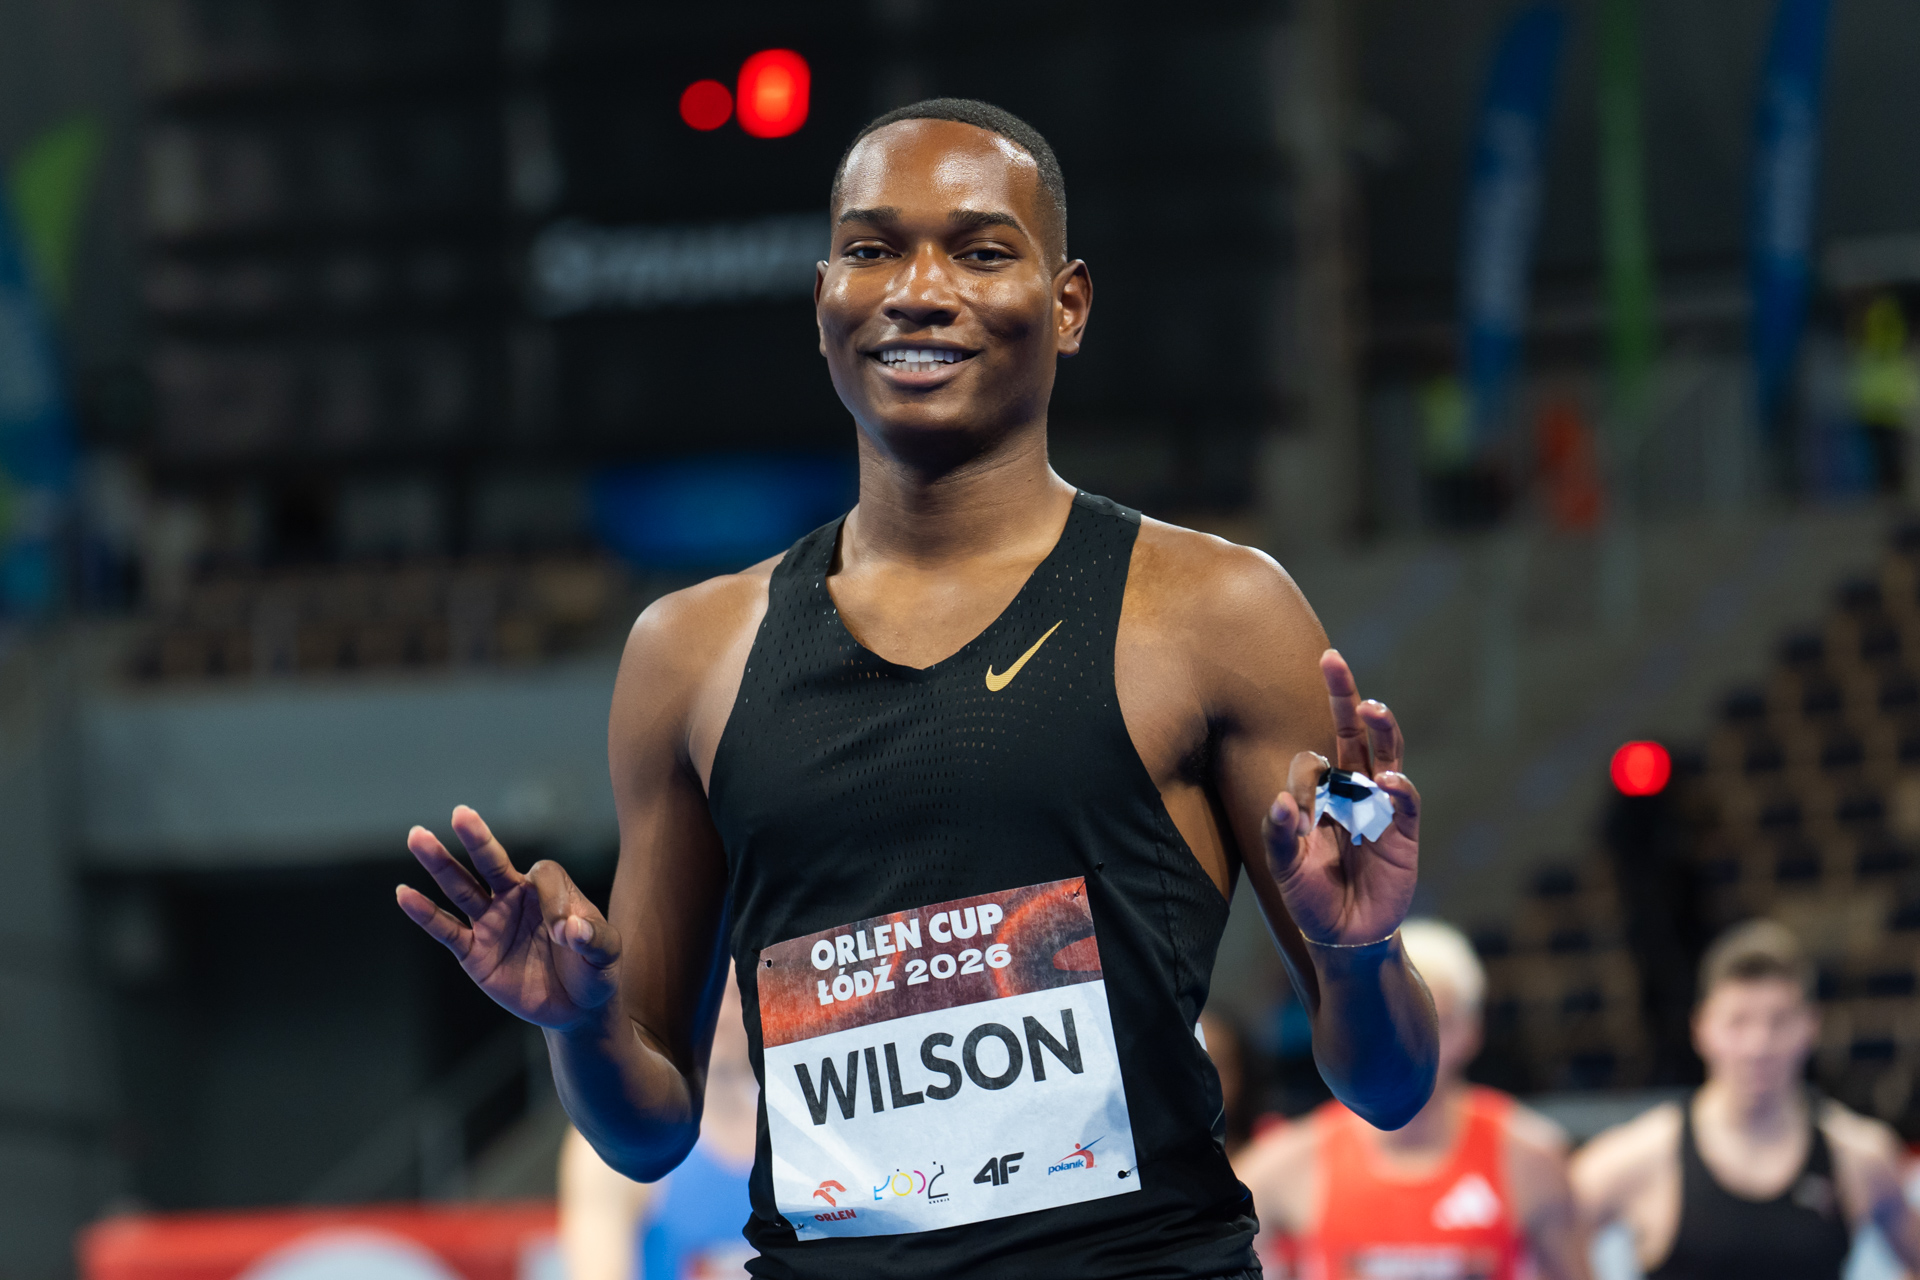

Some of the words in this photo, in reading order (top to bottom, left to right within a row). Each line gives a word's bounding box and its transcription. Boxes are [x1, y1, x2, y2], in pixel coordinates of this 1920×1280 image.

[811, 919, 923, 971] ORLEN
[929, 903, 1004, 944] CUP
[817, 963, 895, 1006] ŁÓDŹ
[905, 943, 1012, 987] 2026
[794, 1008, 1084, 1126] WILSON
[973, 1151, 1025, 1187] 4F
[1047, 1159, 1085, 1176] polanik
[814, 1209, 857, 1222] ORLEN
